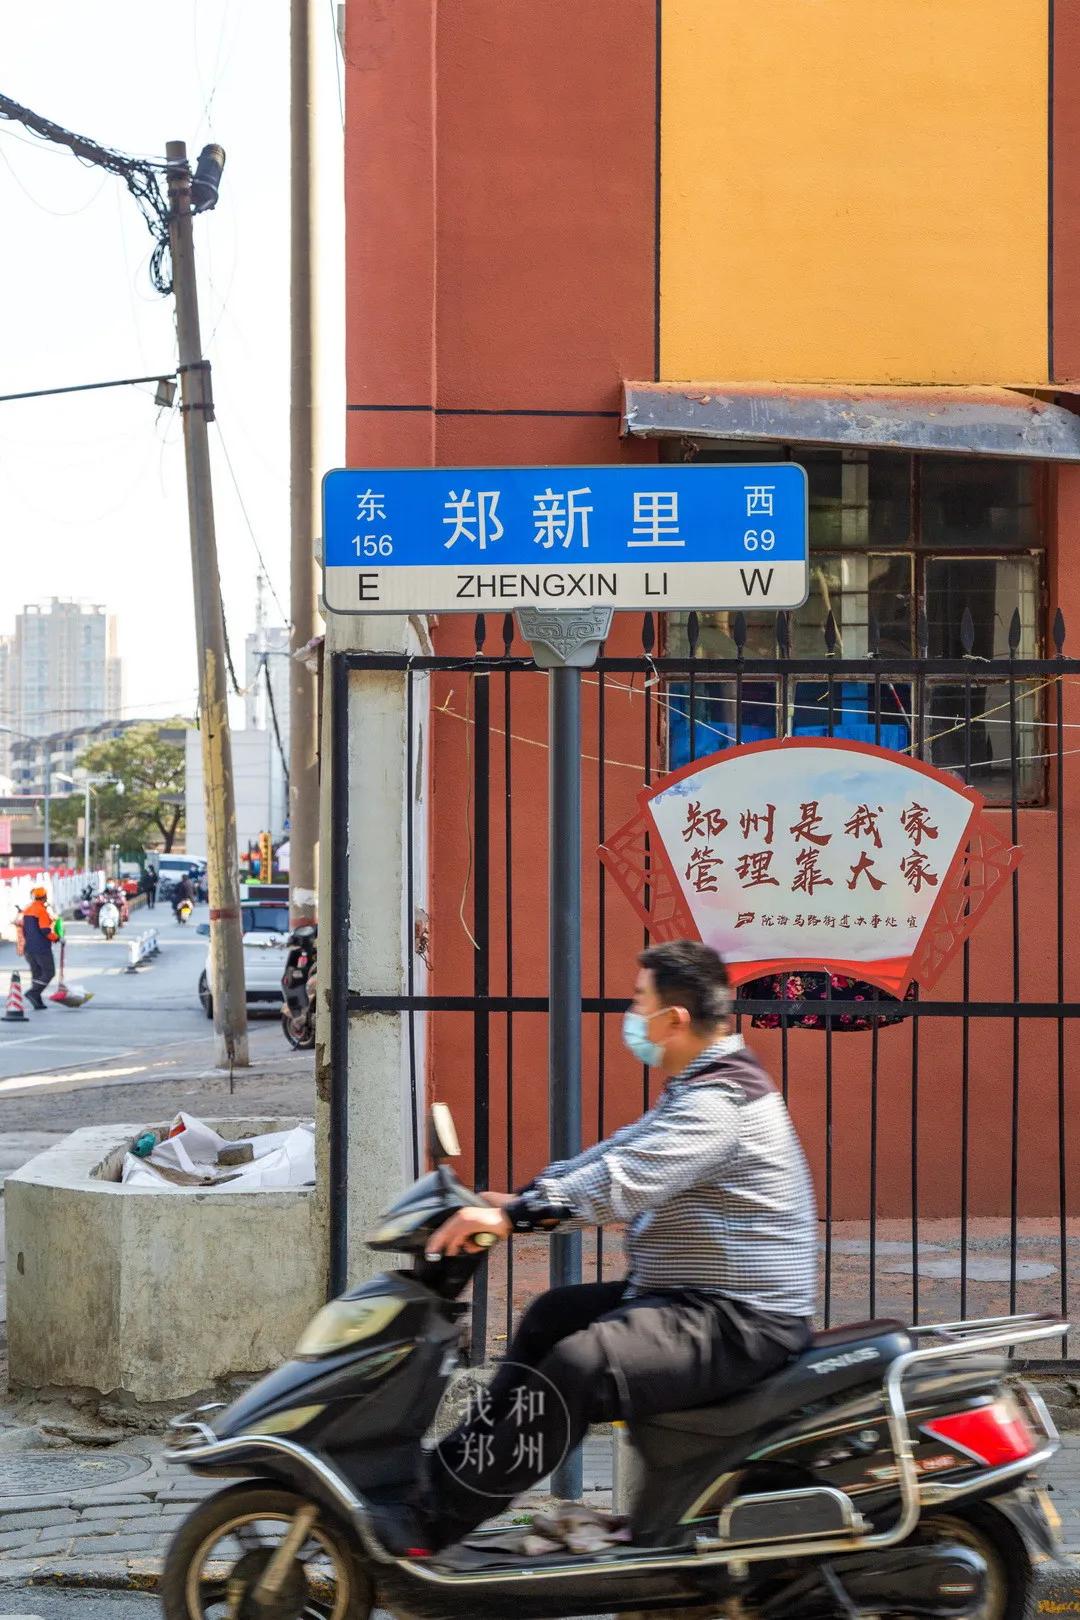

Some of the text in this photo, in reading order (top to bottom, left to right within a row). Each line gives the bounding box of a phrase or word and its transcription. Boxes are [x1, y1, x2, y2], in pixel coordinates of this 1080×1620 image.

[356, 489, 386, 522] 东
[744, 484, 777, 517] 西
[442, 487, 686, 550] 郑新里
[352, 535, 393, 557] 156
[743, 529, 776, 551] 69
[358, 573, 379, 601] E
[456, 572, 668, 598] ZHENGXIN LI
[740, 568, 775, 596] W
[681, 800, 939, 848] 郑州是我家
[685, 847, 938, 895] 管理靠大家
